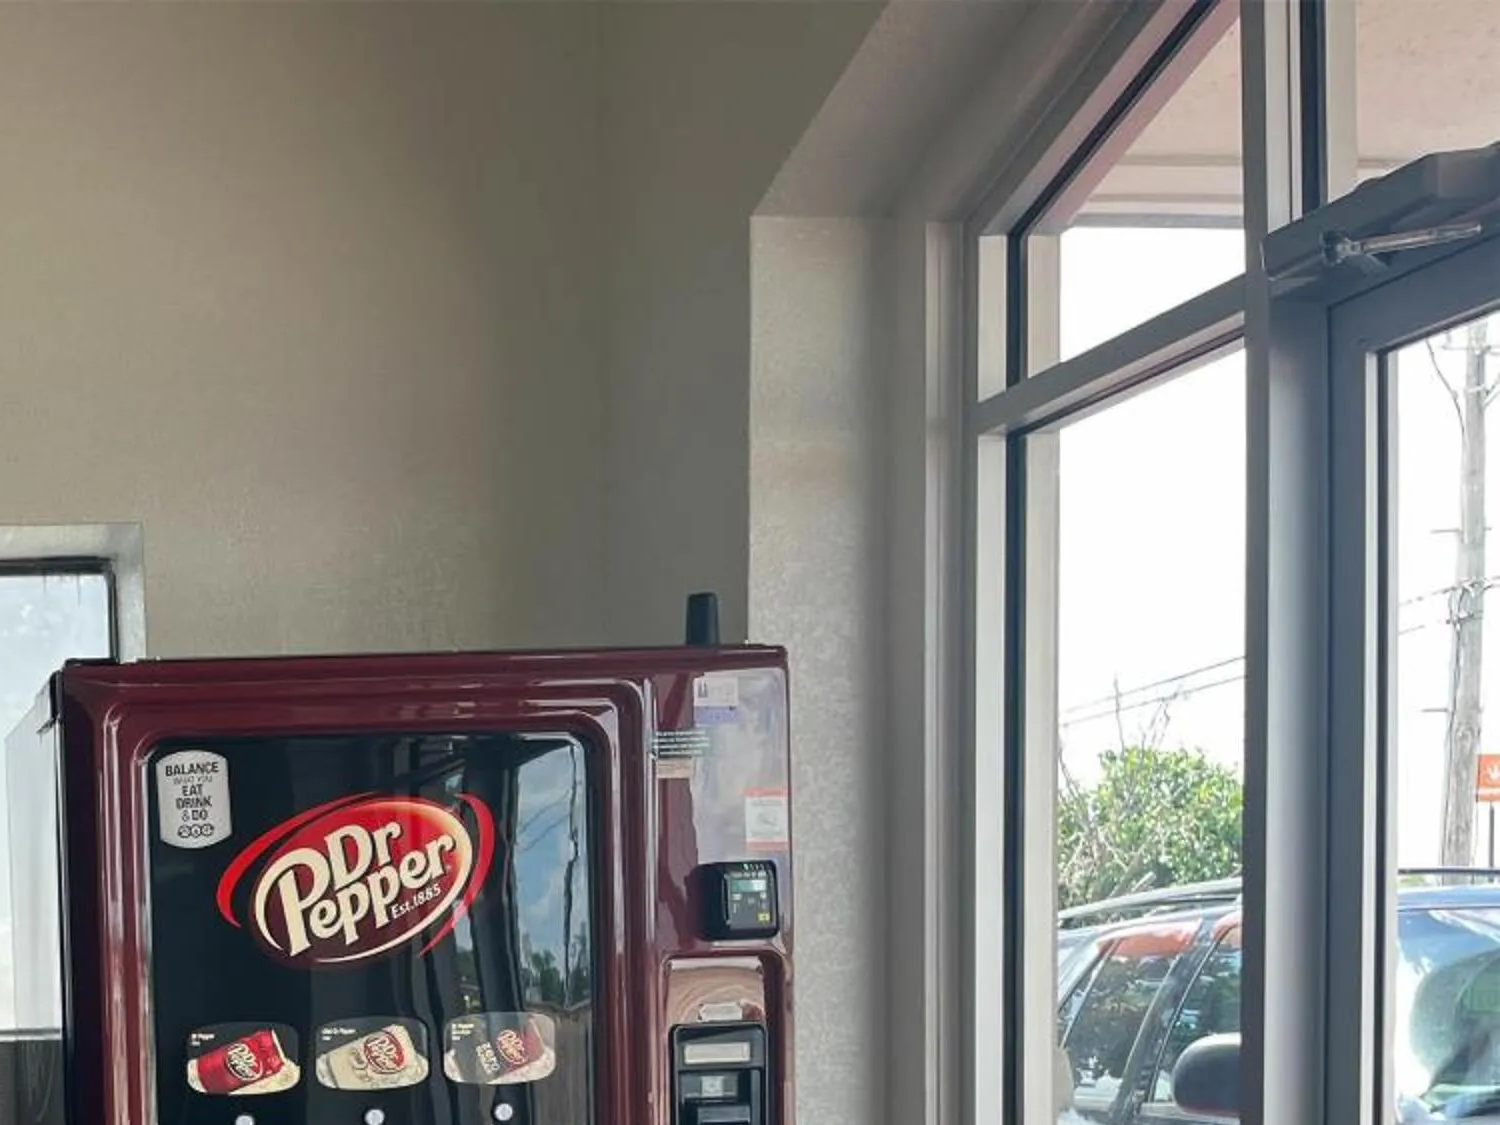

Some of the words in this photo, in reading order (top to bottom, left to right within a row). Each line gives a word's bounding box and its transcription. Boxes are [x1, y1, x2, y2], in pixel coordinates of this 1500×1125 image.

[165, 762, 219, 776] BALANCE
[182, 784, 203, 796] EAT
[175, 797, 212, 810] DRINK
[191, 809, 208, 820] DO
[324, 821, 401, 890] Dr
[257, 834, 455, 957] Pepper
